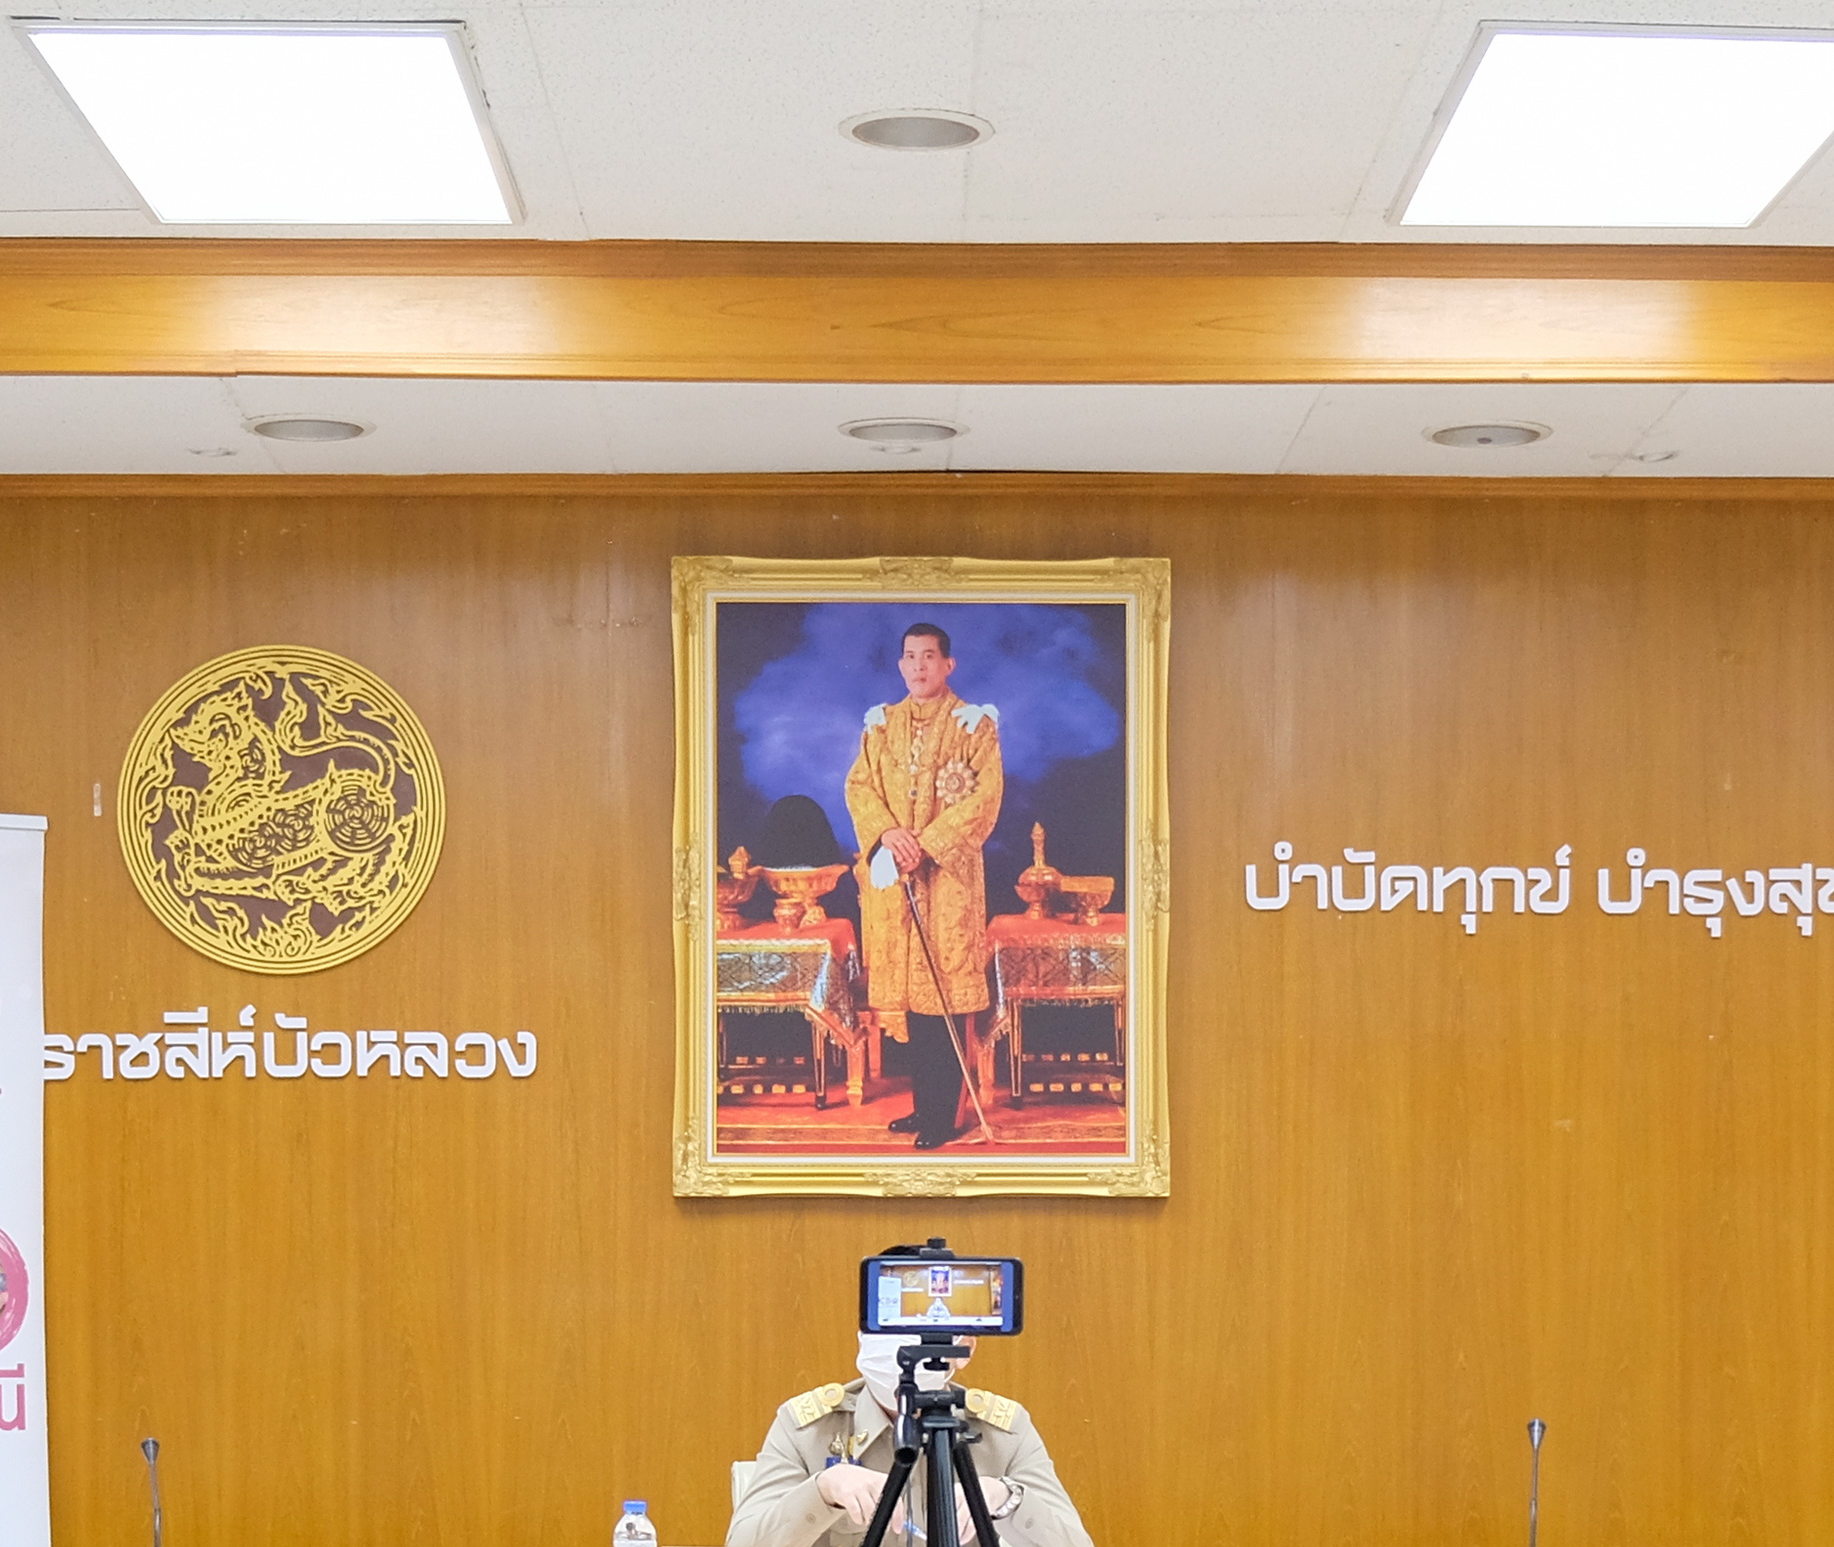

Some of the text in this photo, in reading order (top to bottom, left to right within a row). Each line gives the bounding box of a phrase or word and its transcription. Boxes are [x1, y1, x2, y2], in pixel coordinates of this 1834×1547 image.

[1245, 841, 1572, 934] บำบัดทุกข์
[44, 1004, 538, 1081] ราชสีห์บัวหลวง
